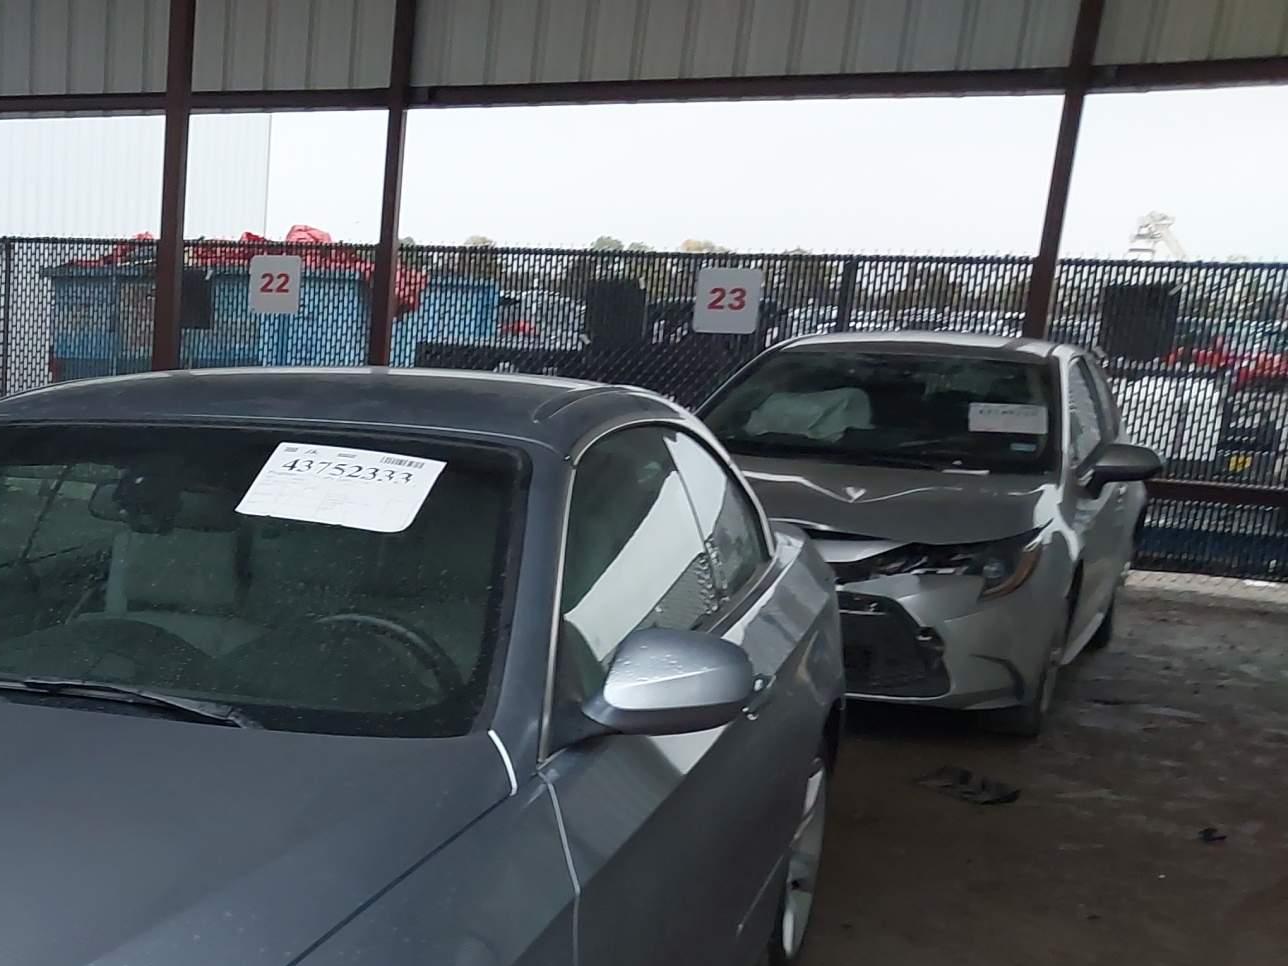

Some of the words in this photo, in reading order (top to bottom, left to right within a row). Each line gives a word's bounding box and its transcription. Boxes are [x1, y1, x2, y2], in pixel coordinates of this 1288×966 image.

[260, 272, 290, 293] 22
[707, 287, 747, 310] 23
[282, 458, 414, 485] 43752333
